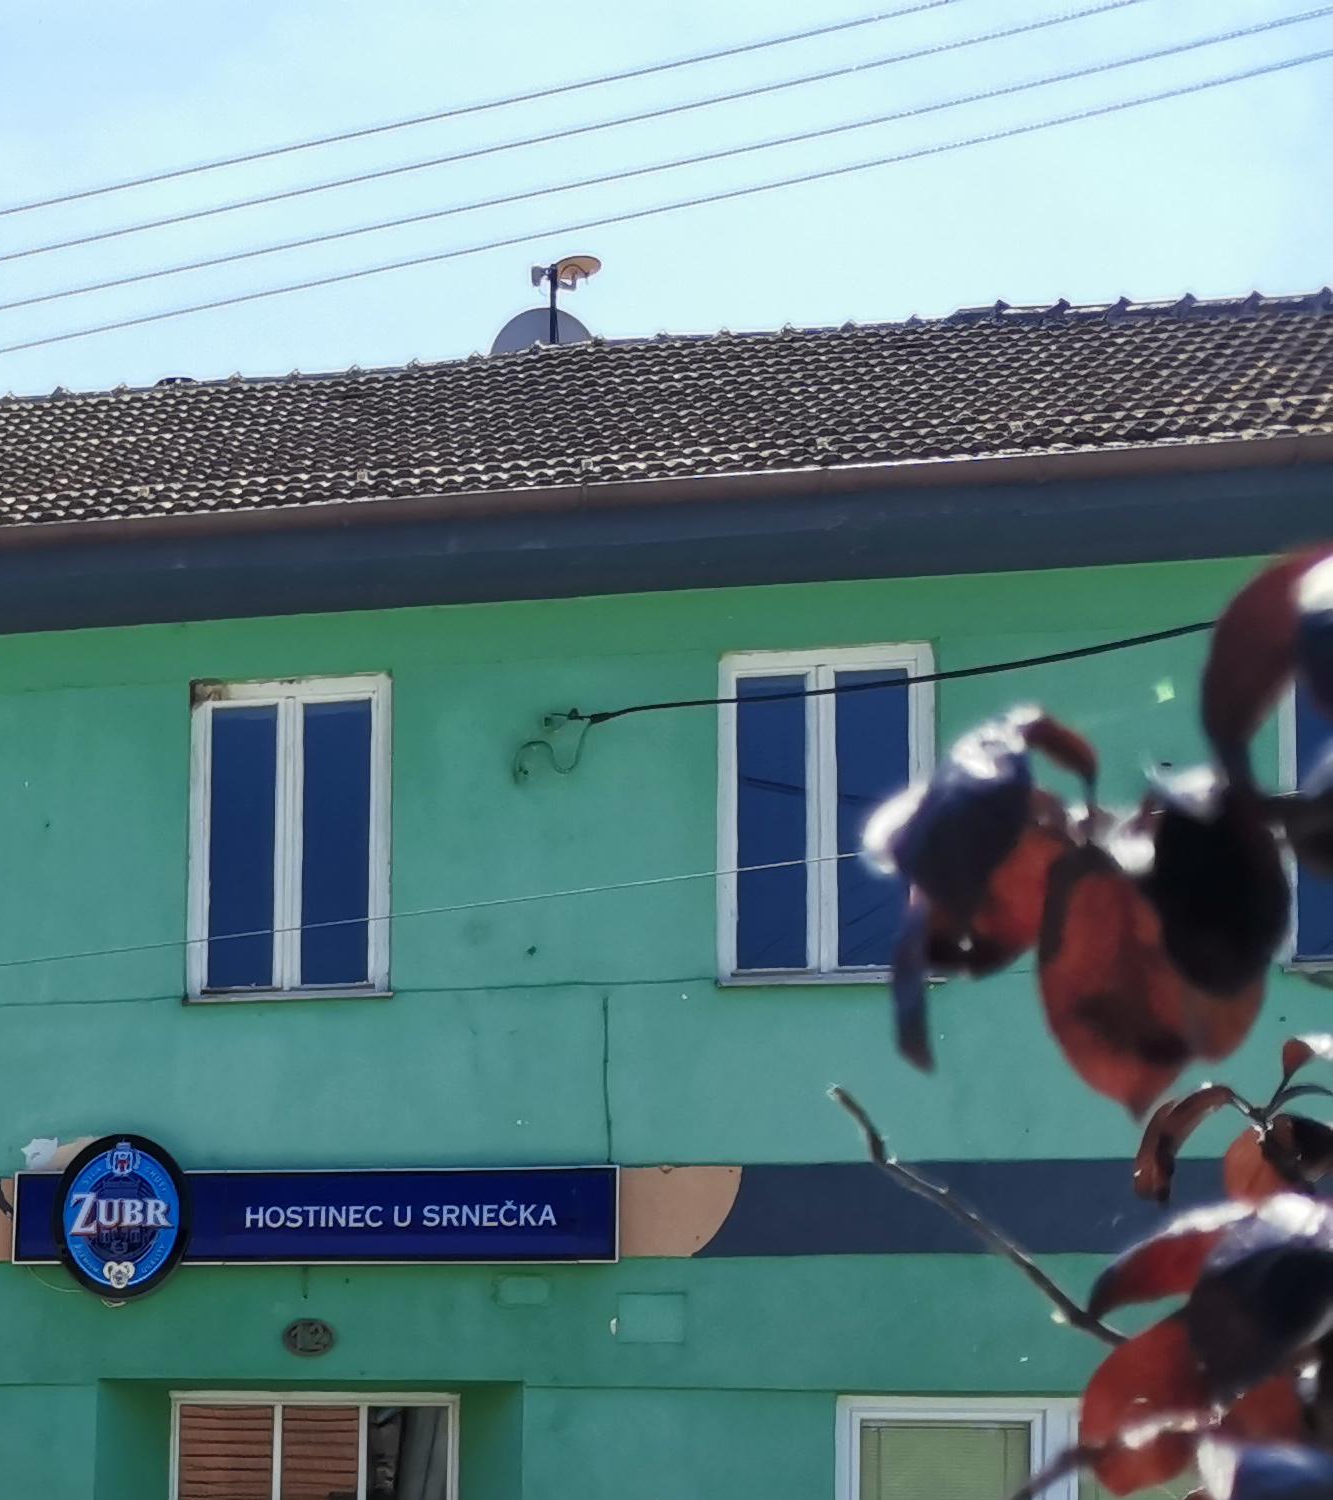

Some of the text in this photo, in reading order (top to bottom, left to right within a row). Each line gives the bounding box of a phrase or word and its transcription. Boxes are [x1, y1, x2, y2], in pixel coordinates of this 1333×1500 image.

[69, 1192, 174, 1235] ZUBR
[244, 1200, 558, 1228] HOSTINEC U SRNEČKA
